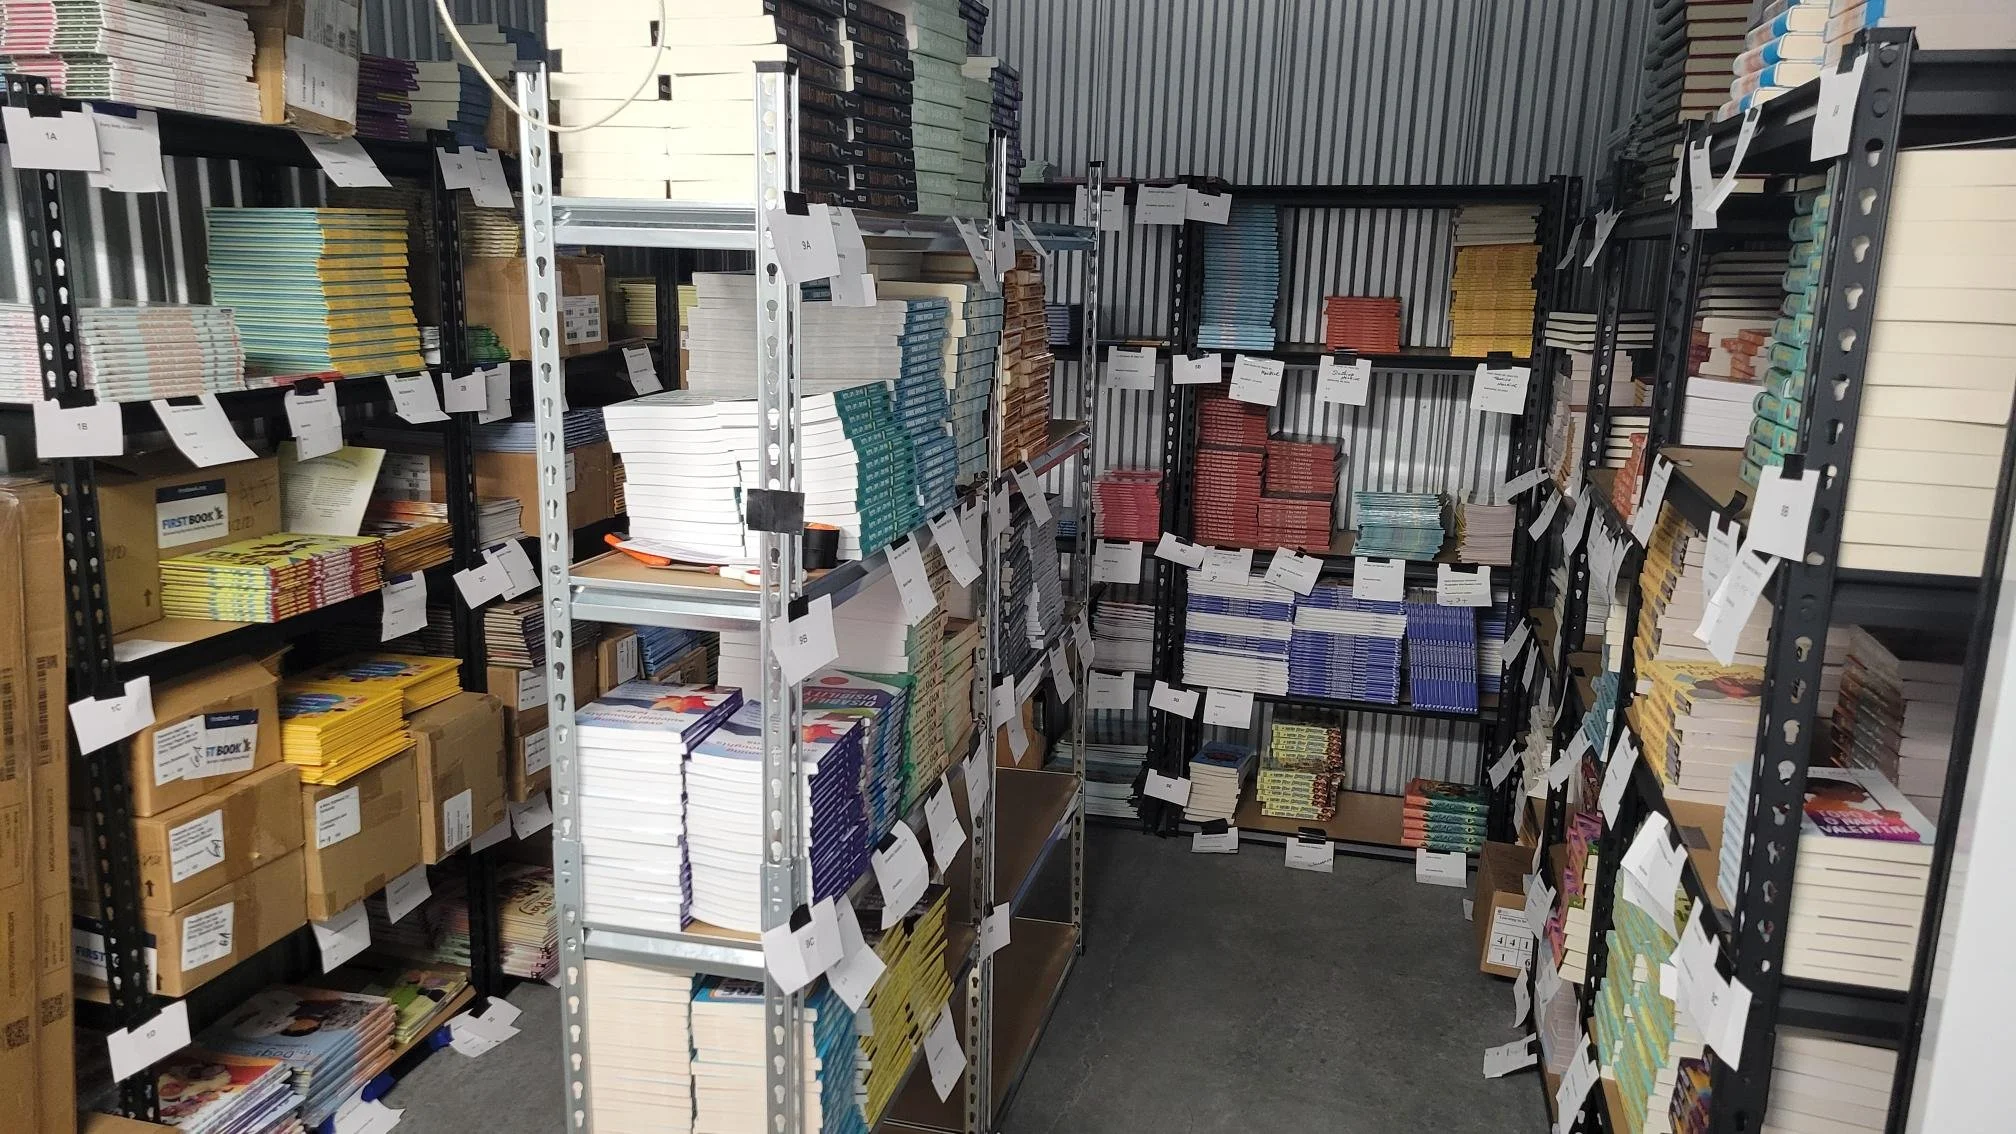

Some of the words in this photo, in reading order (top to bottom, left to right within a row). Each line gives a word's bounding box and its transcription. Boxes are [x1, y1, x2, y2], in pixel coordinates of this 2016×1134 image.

[45, 132, 58, 141] 1A
[801, 240, 812, 250] 9A
[77, 422, 88, 431] 1B
[162, 516, 188, 530] FIRST
[190, 511, 214, 525] BOOK
[799, 634, 809, 645] 9B
[216, 743, 242, 756] BOOK
[1819, 825, 1912, 834] VALENTINA
[1497, 936, 1503, 944] 4
[1509, 938, 1516, 946] 4
